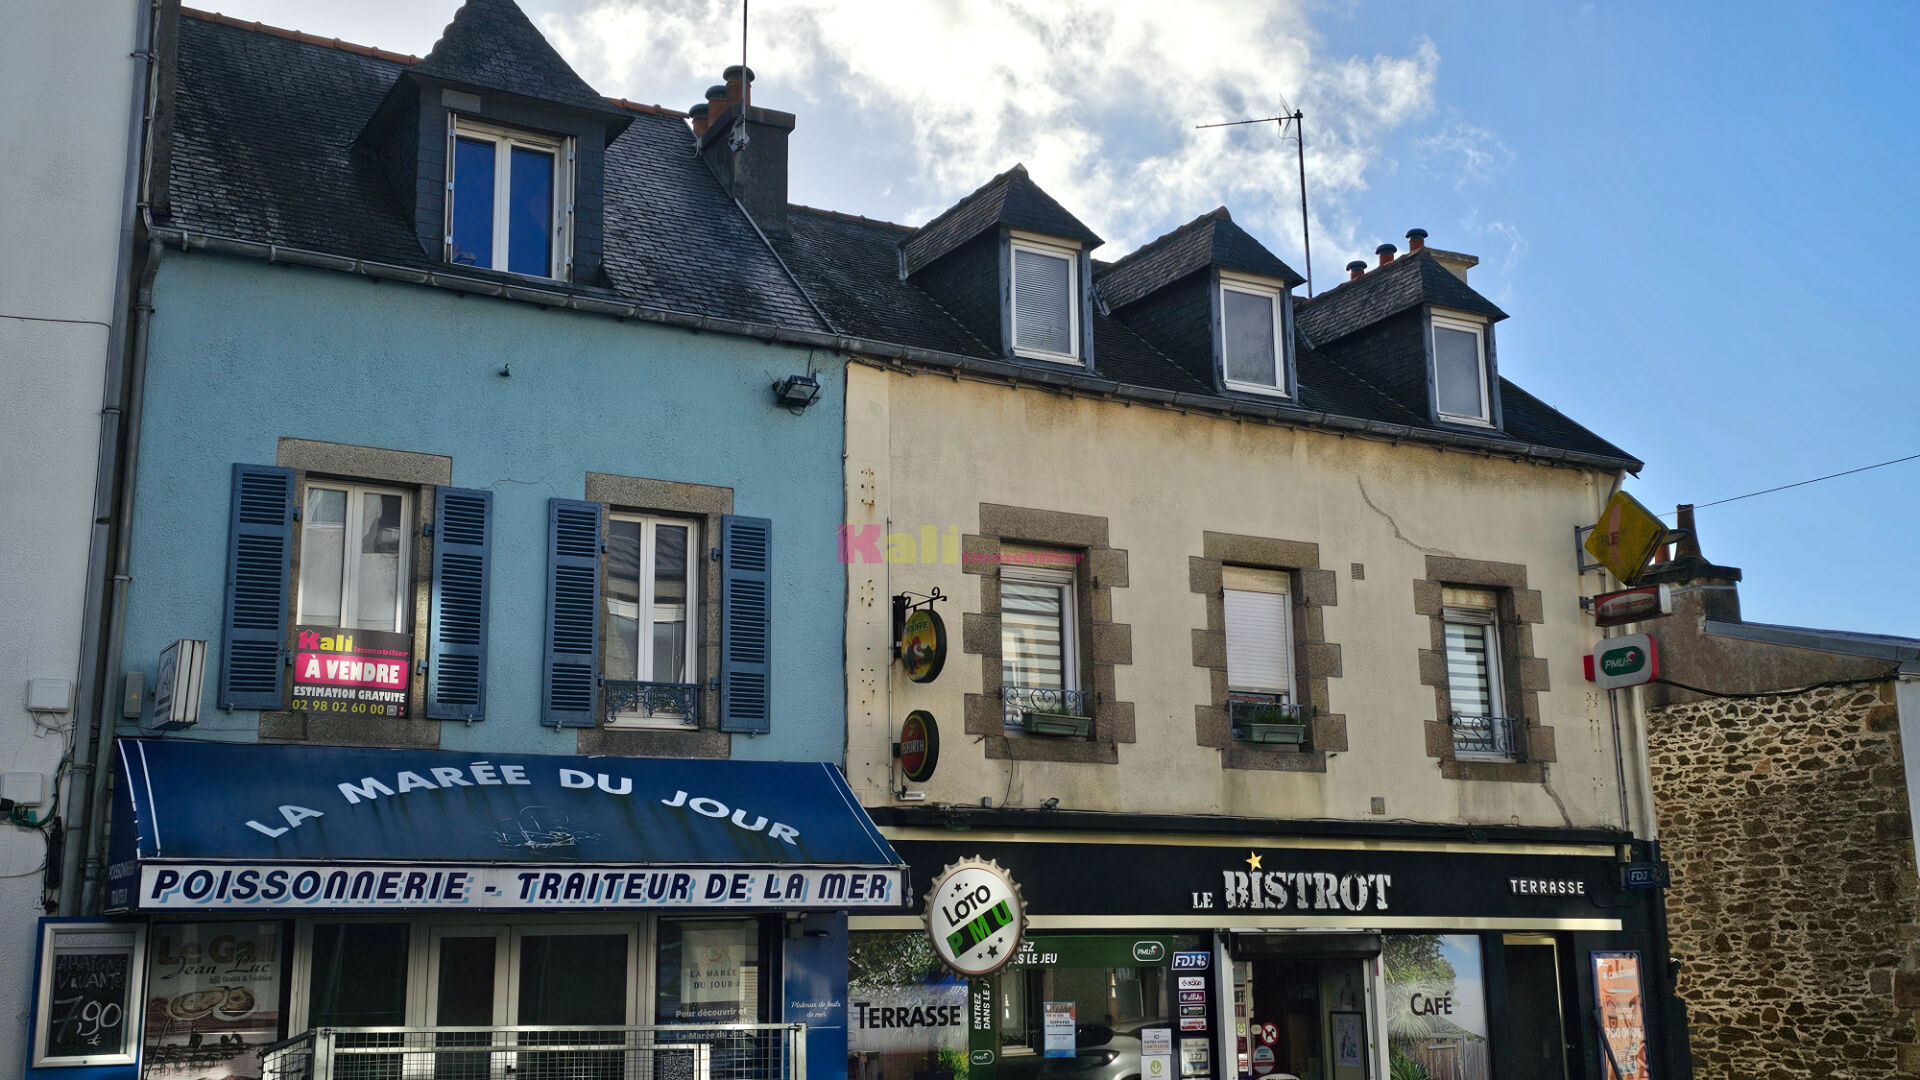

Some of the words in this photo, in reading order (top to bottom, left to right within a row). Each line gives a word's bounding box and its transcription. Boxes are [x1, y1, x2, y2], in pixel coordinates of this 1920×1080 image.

[298, 630, 353, 652] Kali
[353, 646, 409, 657] Immobilier
[304, 654, 321, 679] À
[325, 659, 400, 684] VENDRE
[1604, 656, 1625, 670] PMU
[293, 686, 356, 699] ESTIMATION
[357, 690, 406, 703] GRATUITE
[292, 700, 308, 710] 02
[312, 701, 328, 712] 98
[331, 702, 347, 713] 02
[351, 703, 367, 714] 60
[370, 704, 385, 715] 00
[245, 804, 324, 839] LA
[337, 760, 532, 804] MARÉE
[559, 768, 633, 795] DU
[661, 790, 801, 846] JOUR
[151, 869, 473, 904] POISSONNERIE
[517, 872, 695, 904] TRAITEUR
[704, 873, 752, 903] DE
[763, 873, 804, 902] LA
[817, 873, 890, 903] MER
[1510, 878, 1585, 895] TERRASSE
[1631, 871, 1648, 881] FDJ
[1192, 892, 1213, 909] LE
[1223, 870, 1391, 912] BISTROT
[942, 885, 991, 927] LOTO
[946, 899, 1013, 958] PMU
[158, 935, 202, 965] Le
[208, 933, 276, 964] Gall
[1026, 953, 1038, 964] LE
[1040, 953, 1058, 964] JEU
[1174, 955, 1196, 967] FDJ
[160, 956, 217, 980] Jean
[225, 954, 271, 974] Luc
[690, 970, 701, 978] LA
[694, 981, 706, 989] DU
[710, 981, 733, 989] JOUR
[983, 990, 990, 1001] LE
[675, 1010, 697, 1019] Pour
[698, 1008, 737, 1017] découvrir
[738, 1008, 747, 1016] et
[854, 1002, 961, 1029] TERRASSE
[973, 993, 982, 1030] ENTREZ
[983, 1002, 991, 1030] DANS
[1410, 992, 1453, 1016] CAFÉ
[53, 995, 122, 1043] 7,90
[686, 1031, 715, 1040] Marée
